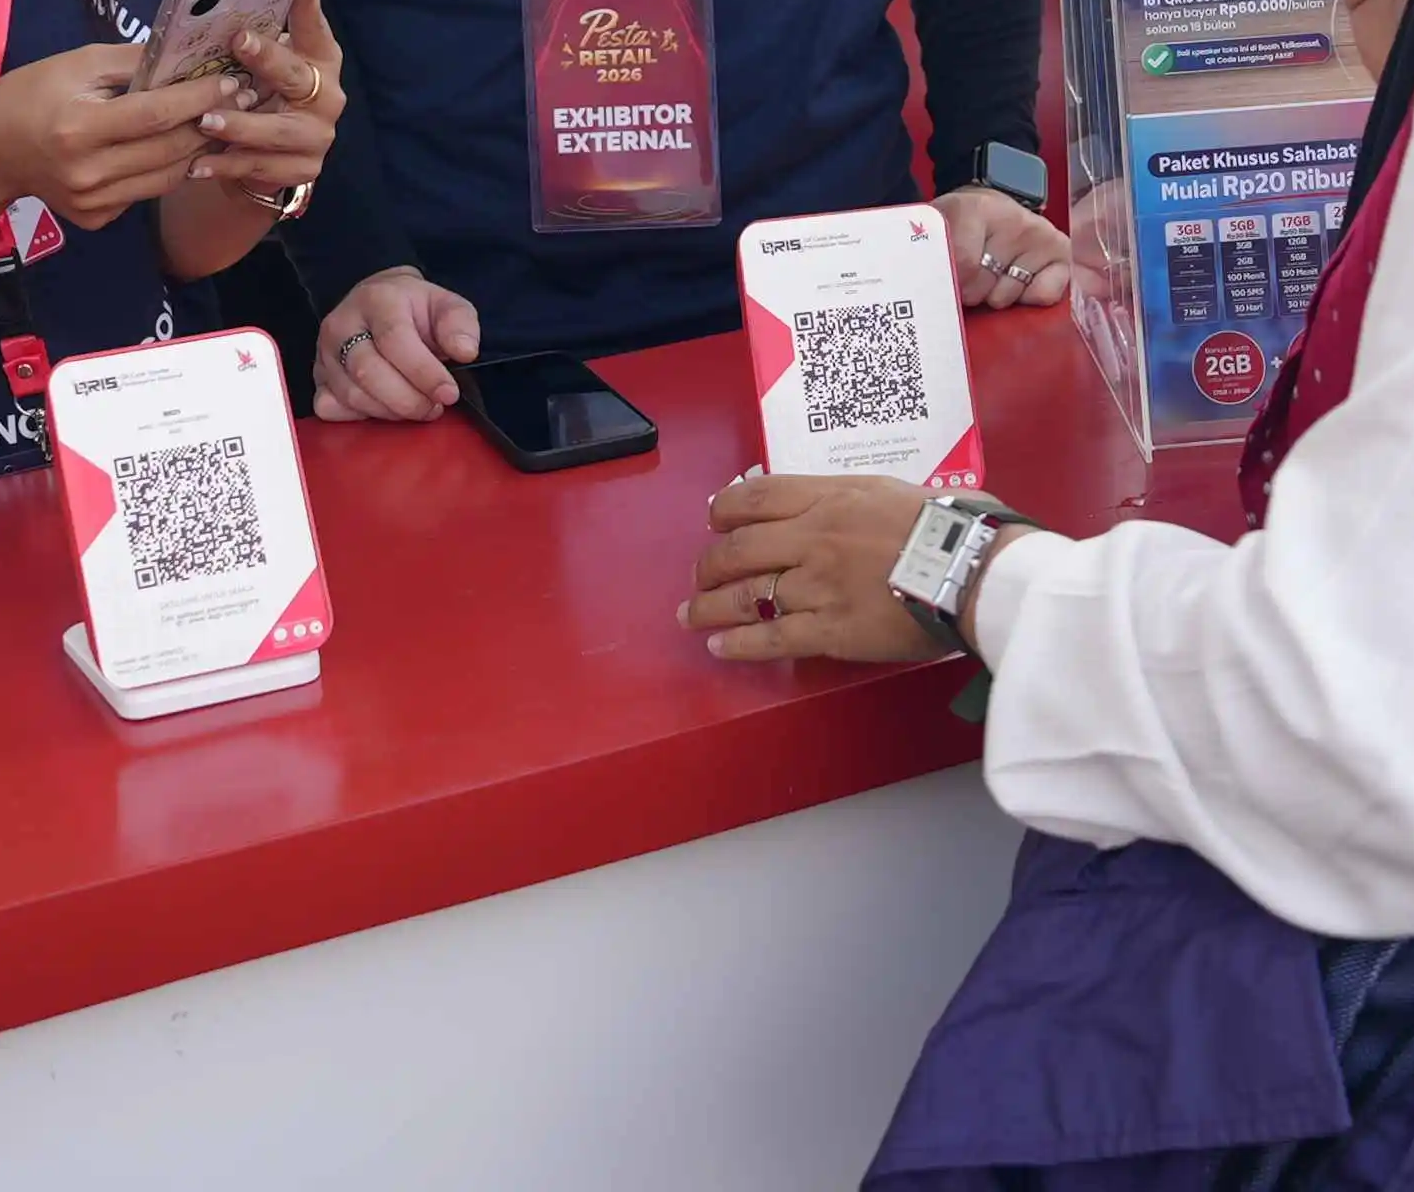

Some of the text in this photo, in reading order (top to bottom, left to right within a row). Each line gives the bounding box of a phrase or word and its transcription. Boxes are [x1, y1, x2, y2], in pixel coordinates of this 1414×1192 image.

[1144, 10, 1182, 22] hanya
[1184, 7, 1218, 19] bayar
[579, 8, 651, 49] Pesta
[1145, 24, 1189, 36] selama
[1203, 19, 1236, 31] bulan
[578, 48, 658, 67] RETAIL
[596, 68, 643, 83] 2026
[553, 103, 694, 130] EXHIBITOR
[557, 129, 692, 154] EXTERNAL
[1158, 143, 1358, 173] Paket Khusus Sahabat
[1161, 178, 1219, 202] Mulai
[1222, 170, 1286, 201] Rp20
[1176, 224, 1202, 236] 3GB
[1229, 219, 1256, 232] 5GB
[1280, 215, 1312, 228] 17GB
[761, 237, 803, 257] QRIS
[1243, 271, 1266, 281] Menit
[1189, 307, 1207, 316] Hari
[1245, 303, 1264, 312] Hari
[1205, 353, 1252, 376] 2GB
[73, 375, 120, 397] QRIS
